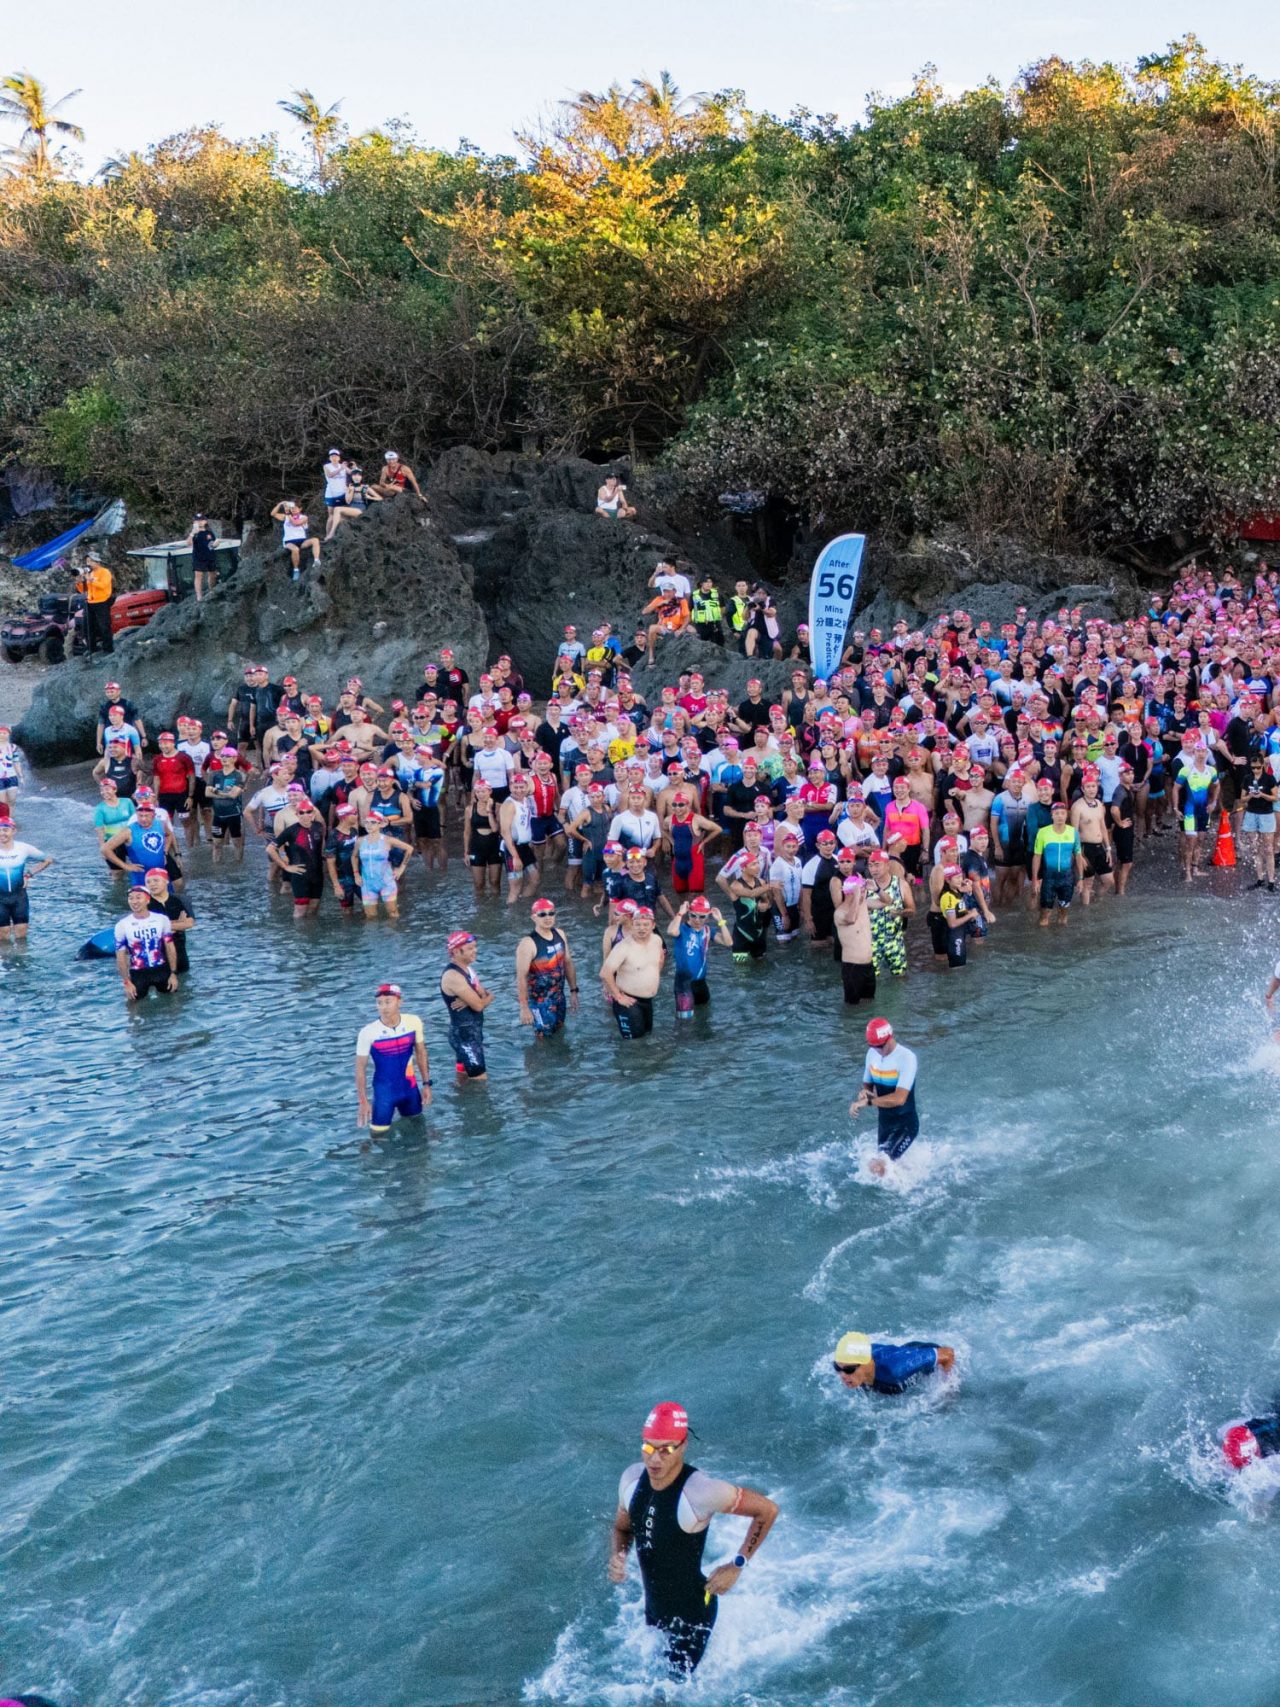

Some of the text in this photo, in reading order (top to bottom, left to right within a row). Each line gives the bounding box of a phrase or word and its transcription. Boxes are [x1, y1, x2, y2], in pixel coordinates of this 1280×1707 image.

[828, 559, 850, 568] After
[817, 573, 855, 600] 56
[824, 605, 844, 614] Mins
